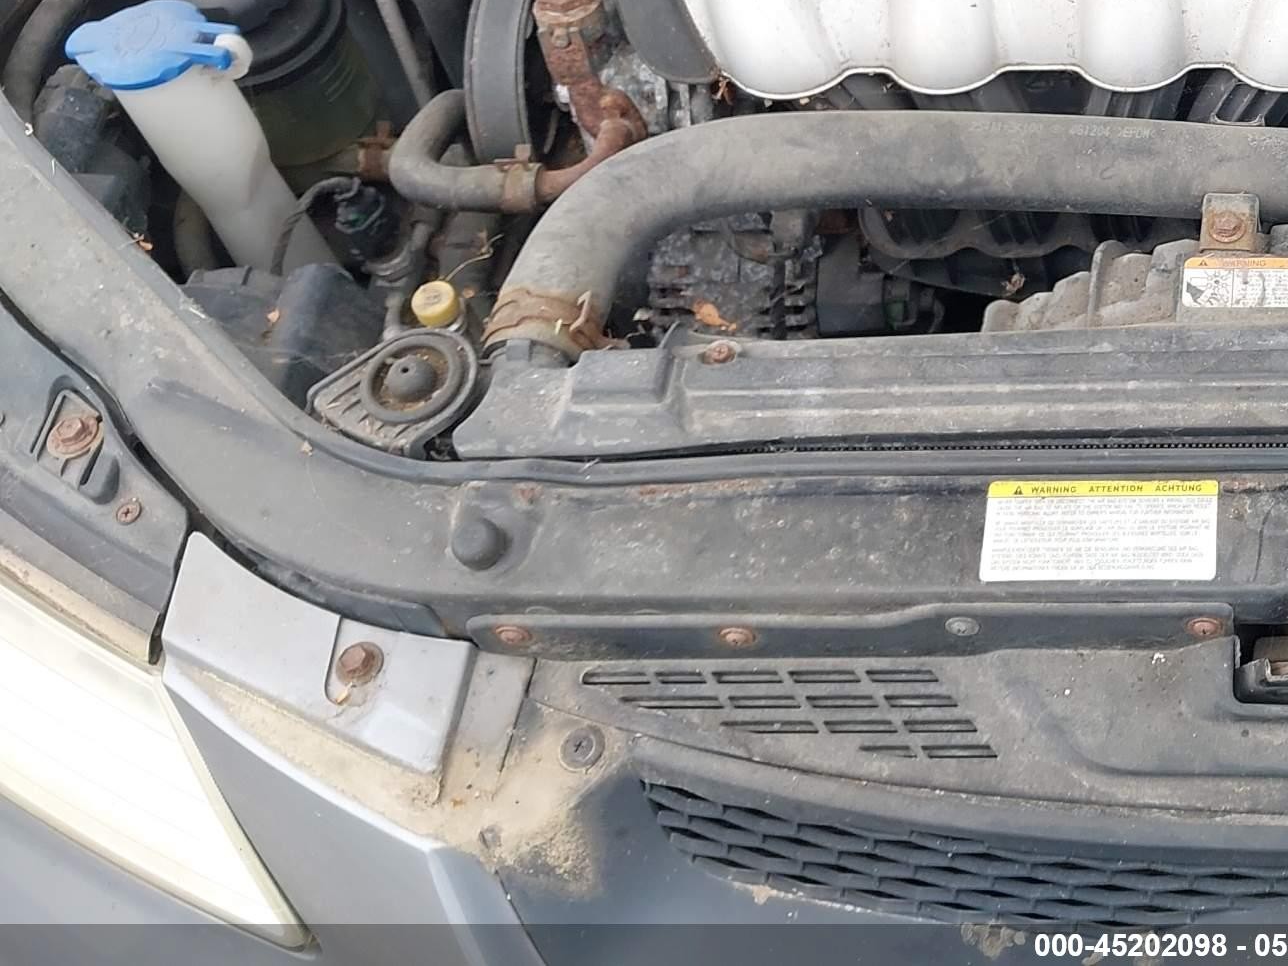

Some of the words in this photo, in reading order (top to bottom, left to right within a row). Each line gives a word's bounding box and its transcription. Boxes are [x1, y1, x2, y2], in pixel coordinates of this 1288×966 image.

[1031, 485, 1077, 494] WARNING
[1088, 485, 1144, 493] ATTENTION
[1155, 484, 1203, 493] ACHTUNG
